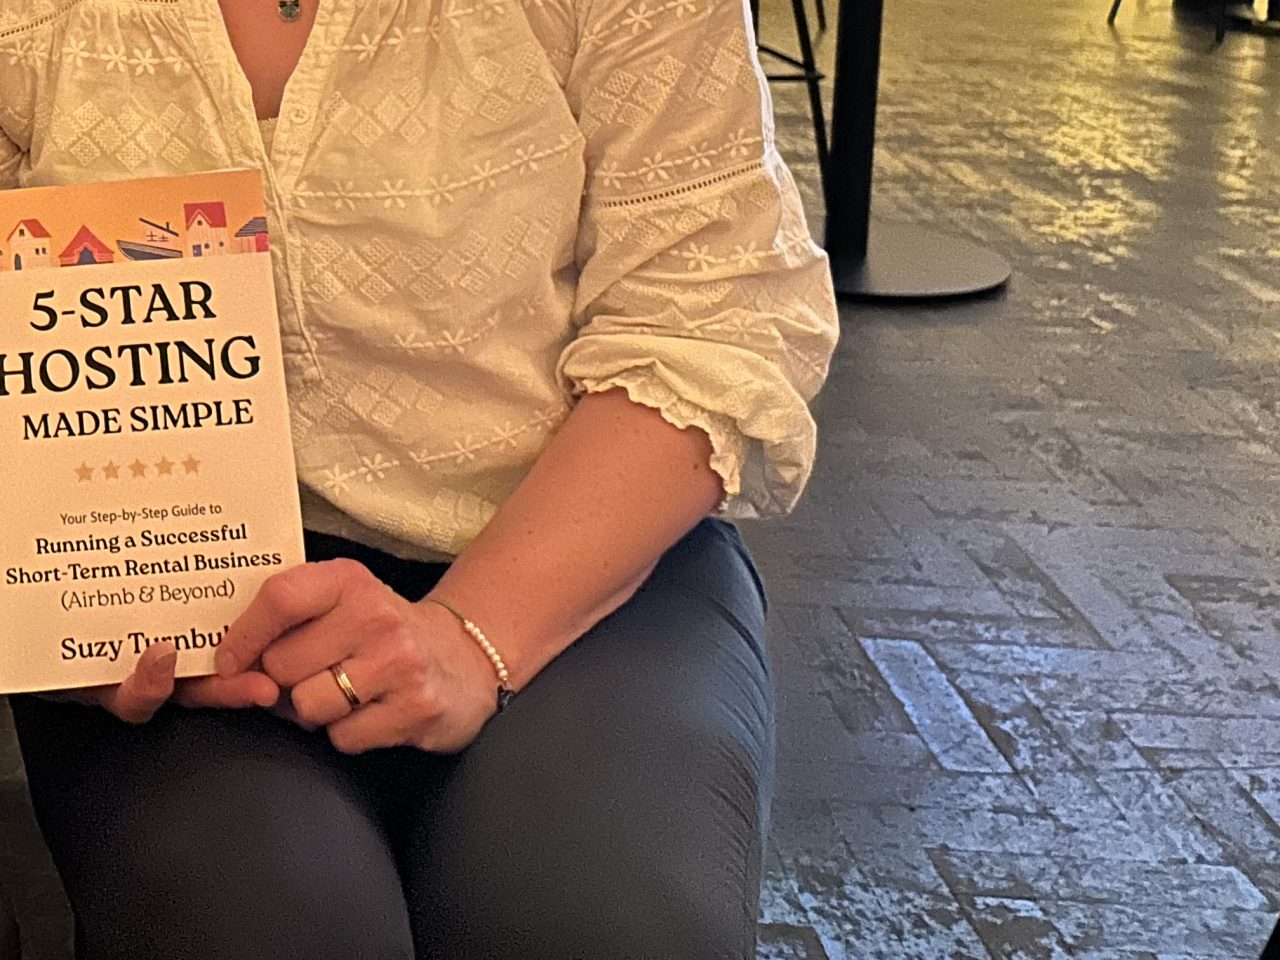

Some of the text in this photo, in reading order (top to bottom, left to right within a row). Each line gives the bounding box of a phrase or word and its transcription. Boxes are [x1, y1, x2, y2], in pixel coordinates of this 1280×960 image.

[29, 280, 217, 331] 5-STAR
[22, 399, 254, 440] MADE SIMPLE
[60, 503, 222, 525] Your Step-by-Step Guide to
[35, 523, 248, 555] Running a Successful
[5, 552, 283, 585] Short-Term Rental Business
[61, 578, 235, 611] (Airbnb & Beyond)
[61, 637, 123, 662] Suzy
